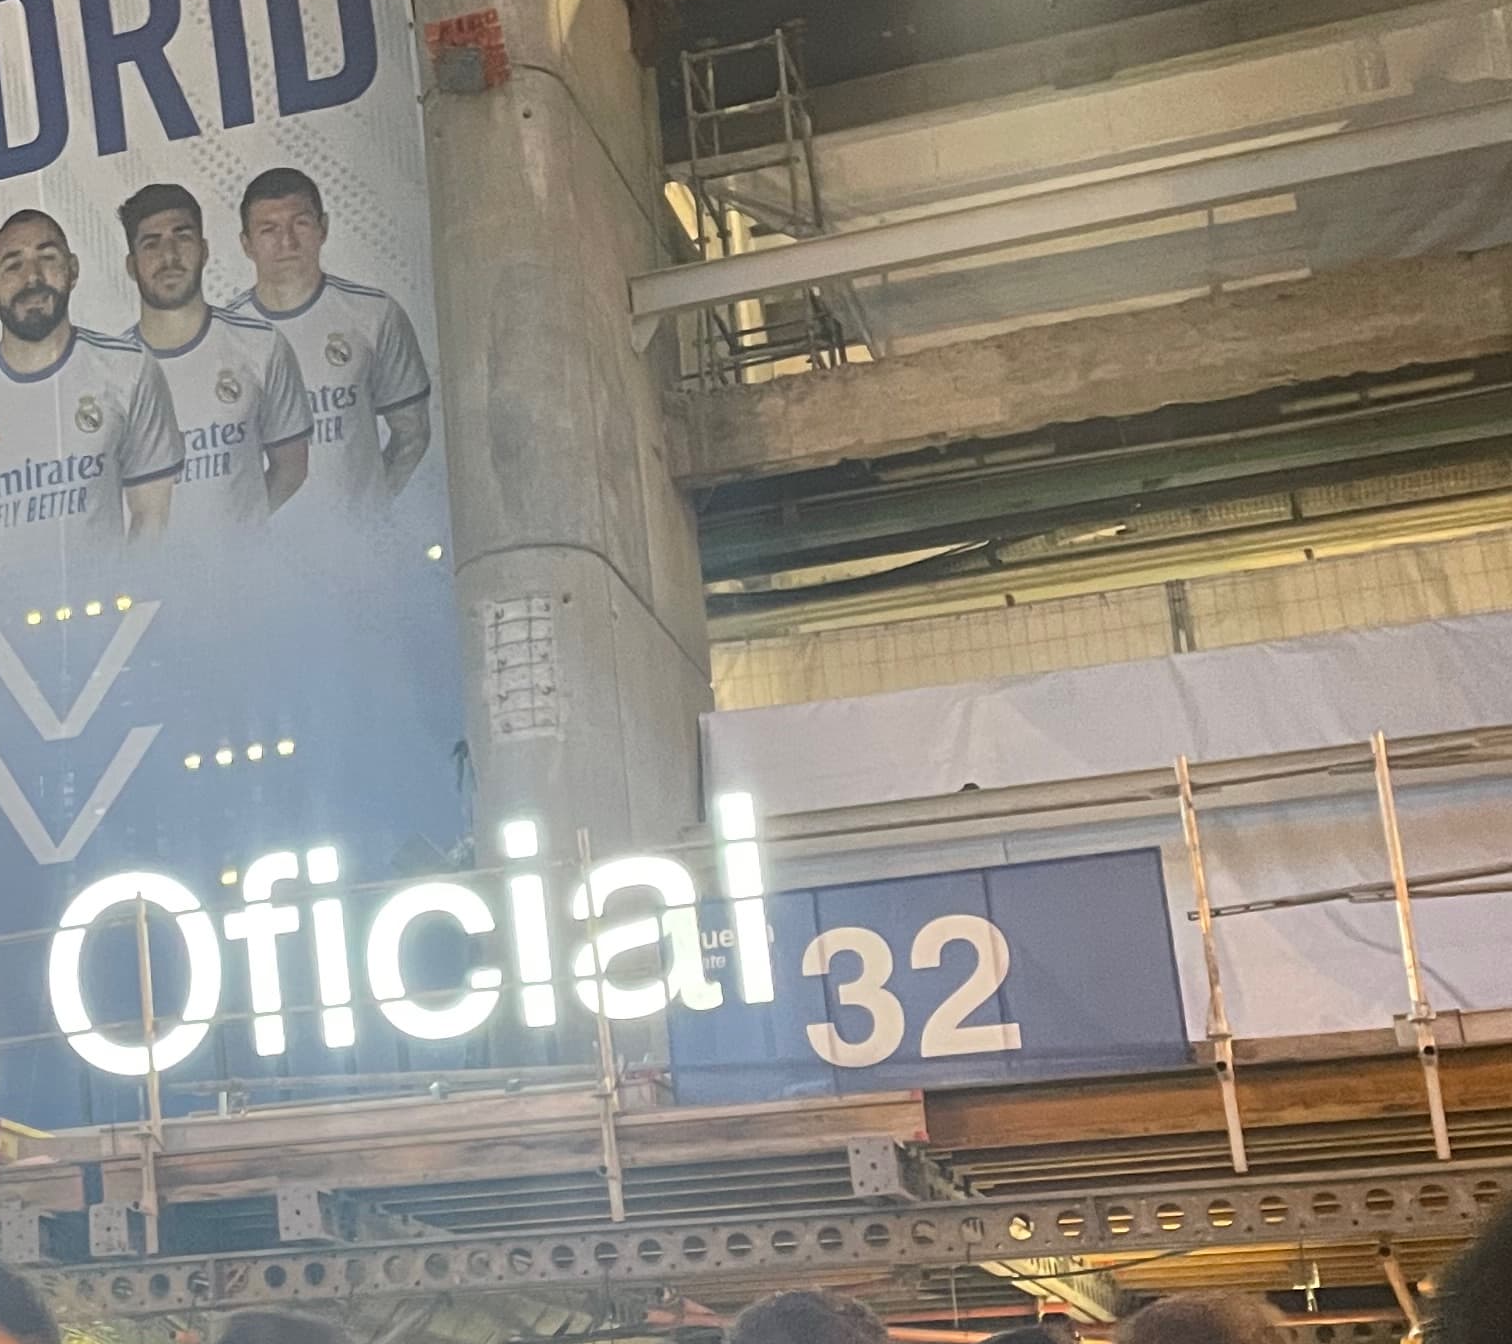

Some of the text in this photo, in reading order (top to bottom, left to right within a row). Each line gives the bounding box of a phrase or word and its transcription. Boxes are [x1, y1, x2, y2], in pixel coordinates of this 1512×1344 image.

[183, 420, 248, 452] rates
[25, 486, 89, 523] BETTER
[48, 791, 774, 1075] Oficial
[800, 913, 1022, 1068] 32
